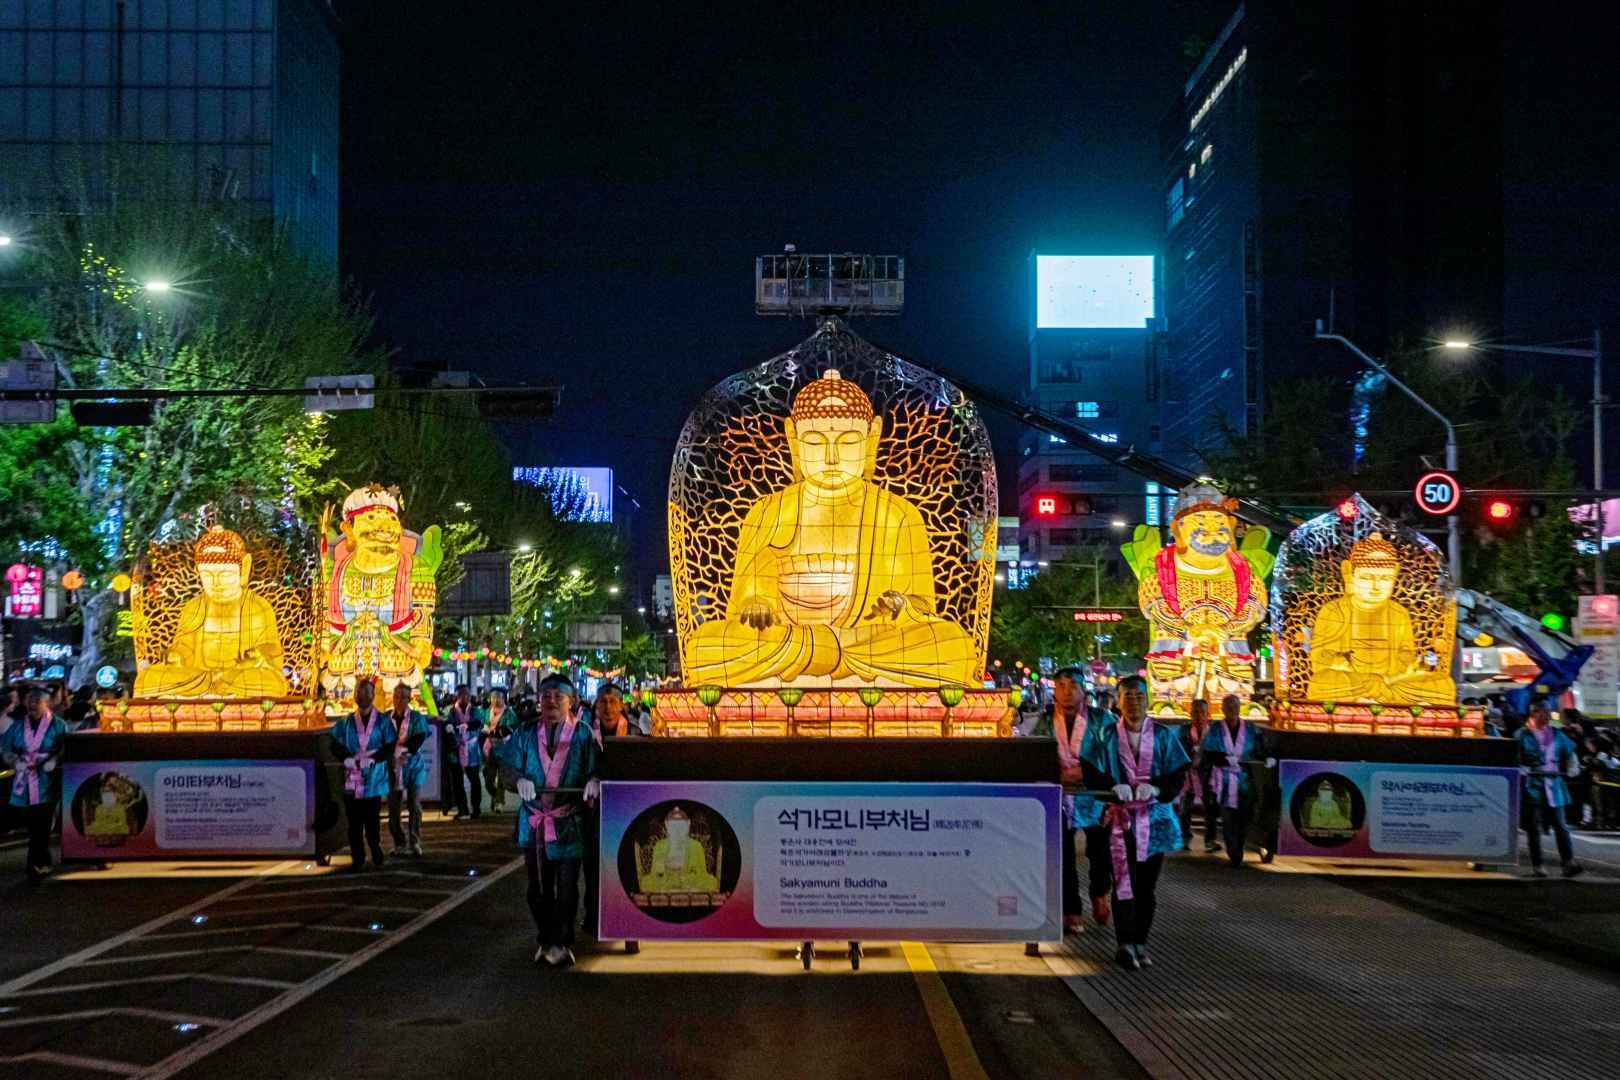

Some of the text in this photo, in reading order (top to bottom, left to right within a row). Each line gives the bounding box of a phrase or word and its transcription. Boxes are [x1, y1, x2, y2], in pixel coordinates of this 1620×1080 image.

[1424, 483, 1451, 503] 50
[163, 774, 241, 789] 아미타부처님
[777, 808, 930, 832] 석가모니부처님
[780, 877, 888, 890] Sakyamuni Buddha
